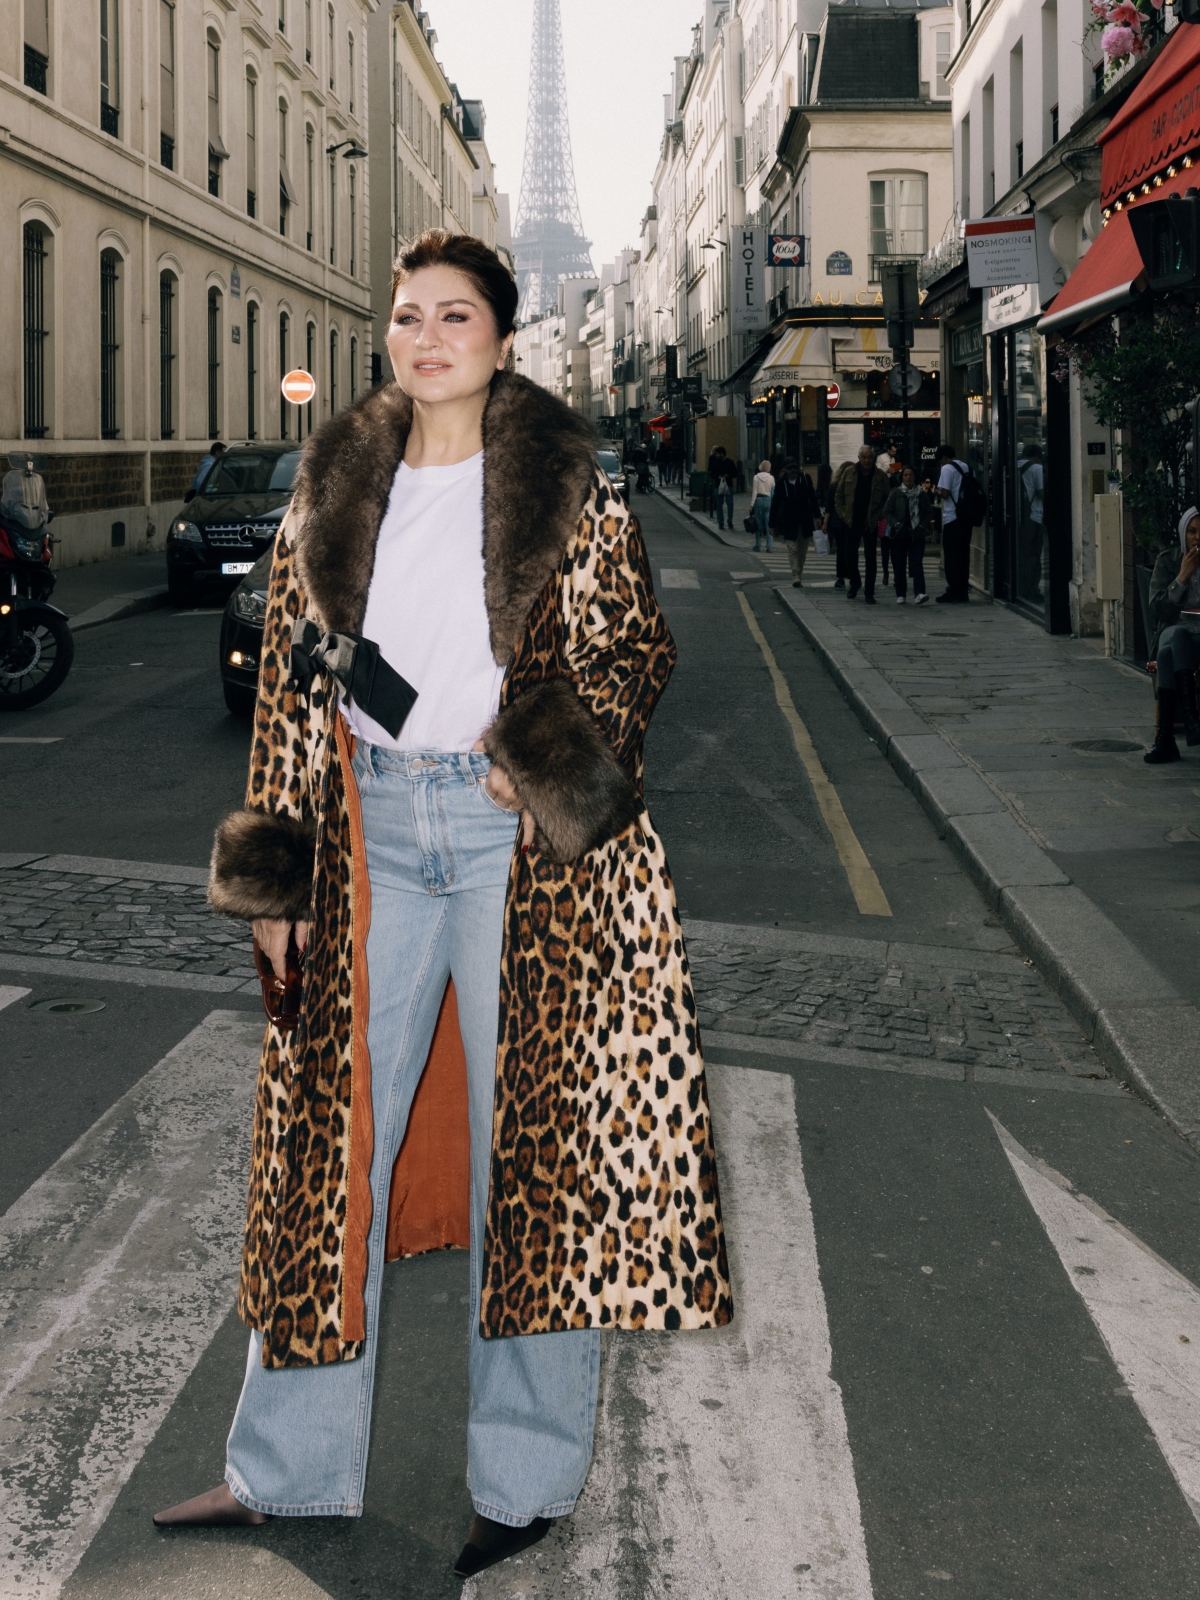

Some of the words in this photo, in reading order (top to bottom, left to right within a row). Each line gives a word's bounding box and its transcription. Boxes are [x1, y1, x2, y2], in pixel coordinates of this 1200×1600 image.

[775, 244, 797, 254] 1664
[984, 257, 1021, 265] E-cigarettes
[742, 231, 755, 306] HOTEL
[986, 273, 1022, 281] Accessoires
[813, 291, 843, 306] AU
